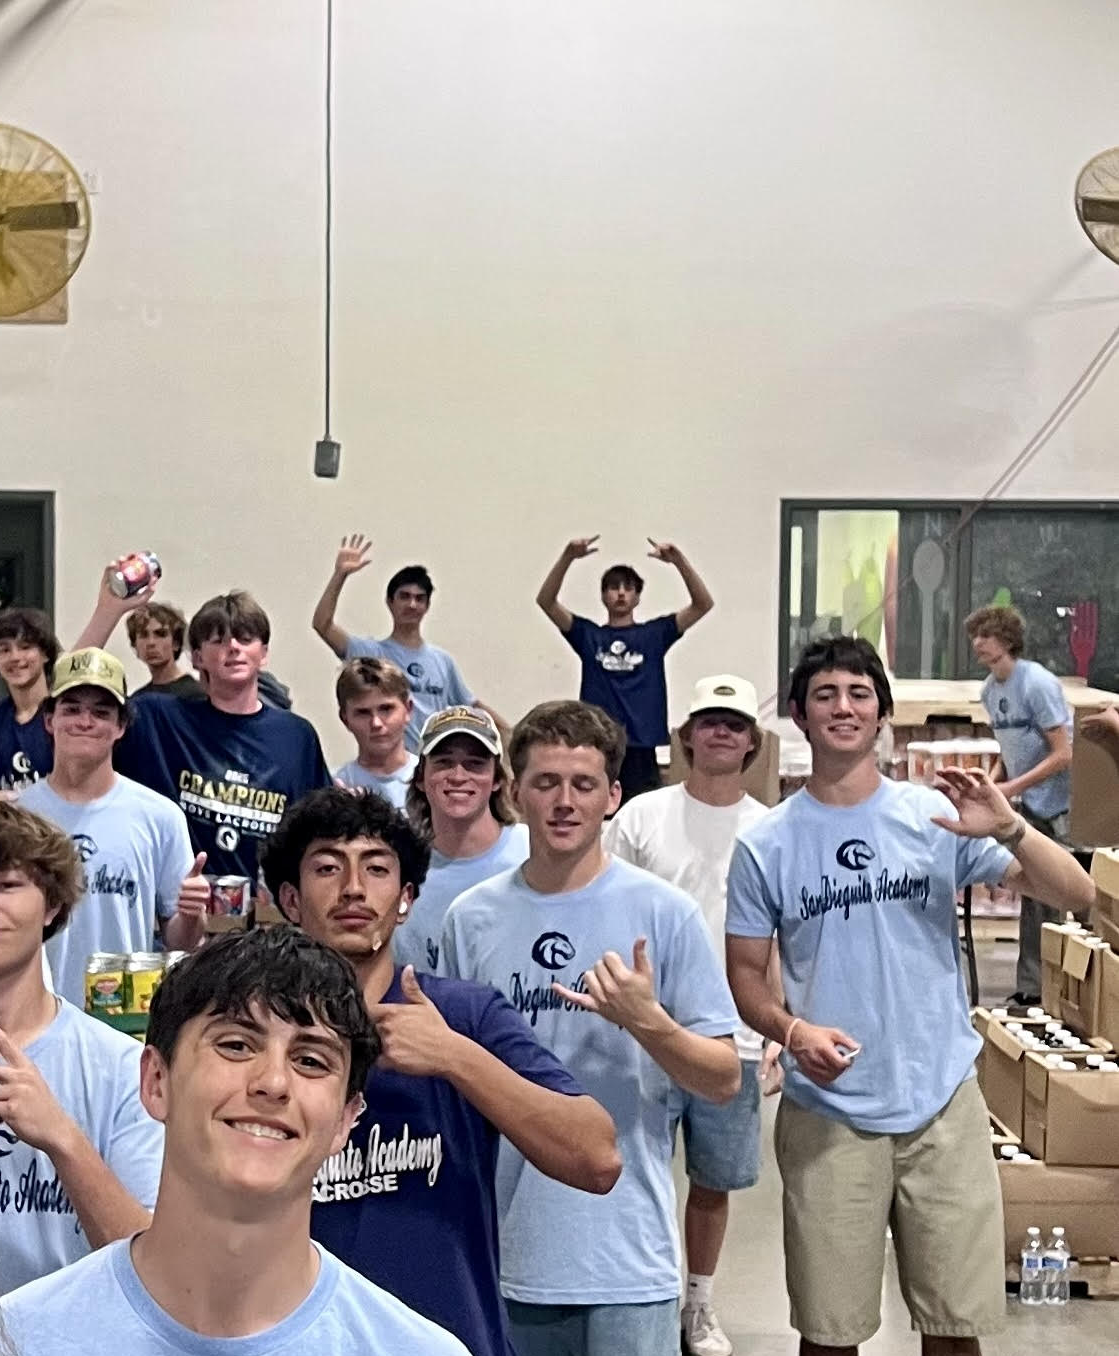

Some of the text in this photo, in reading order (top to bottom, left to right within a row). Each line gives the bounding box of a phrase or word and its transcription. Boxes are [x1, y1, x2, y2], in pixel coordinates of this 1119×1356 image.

[875, 868, 931, 912] Academy
[365, 1123, 443, 1187] Academy
[311, 1174, 399, 1203] ACROSSE
